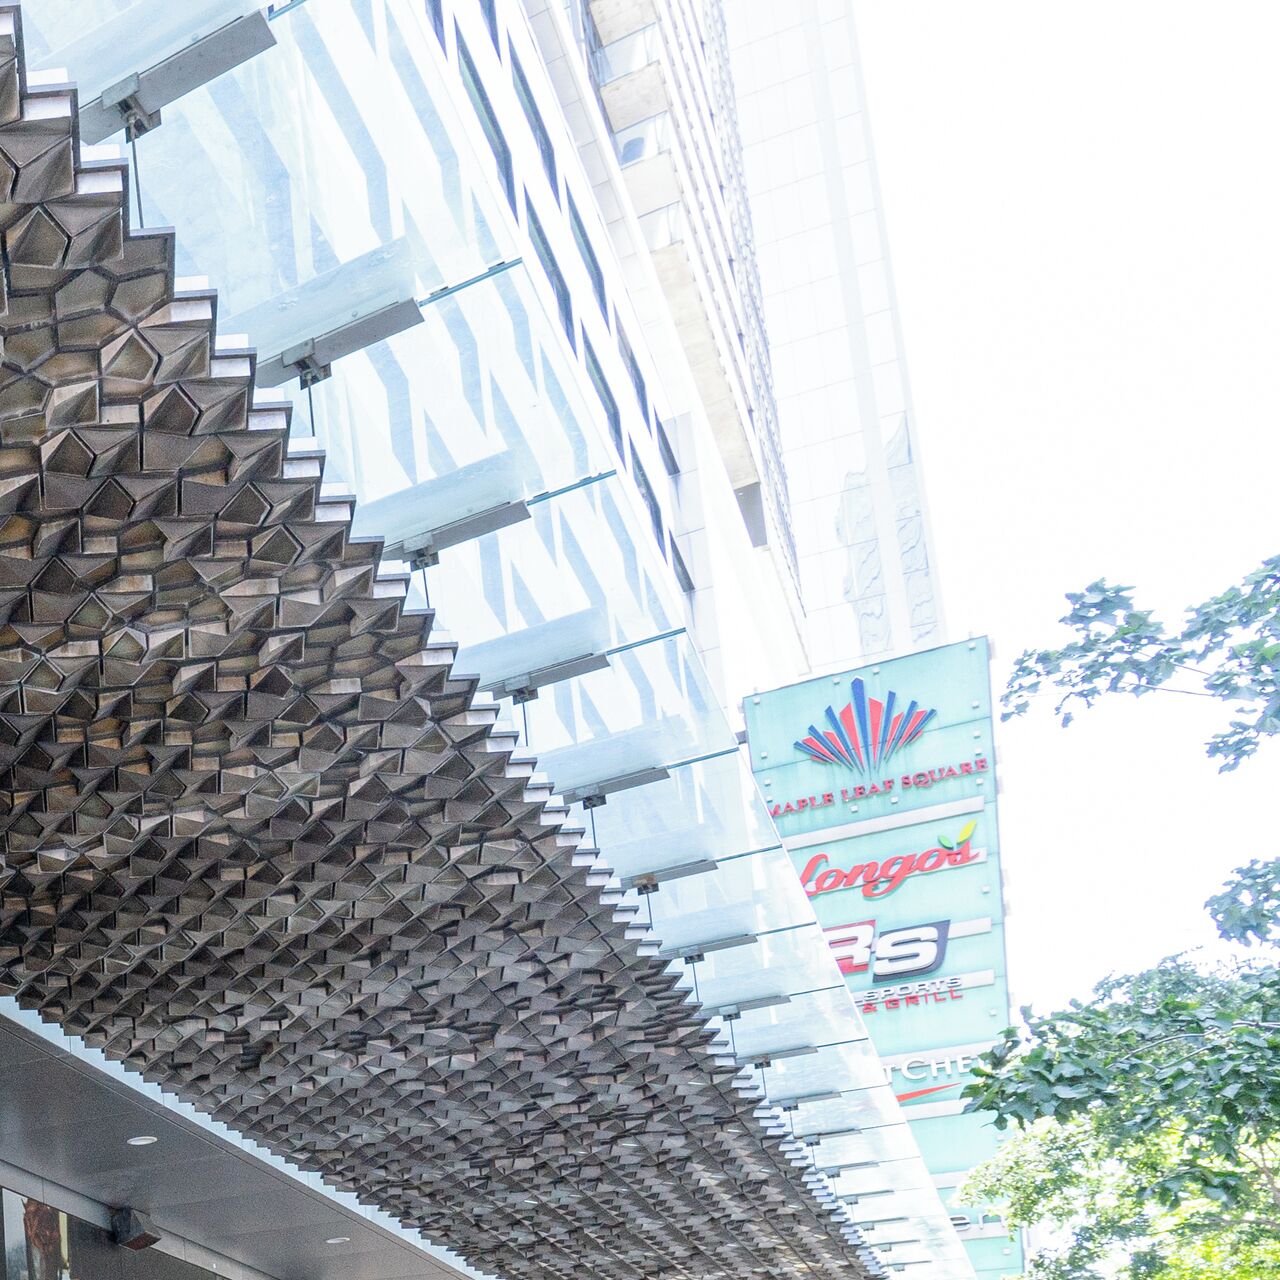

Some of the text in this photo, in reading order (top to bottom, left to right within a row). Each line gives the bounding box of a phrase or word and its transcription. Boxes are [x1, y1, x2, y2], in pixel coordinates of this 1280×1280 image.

[770, 757, 989, 818] MAPLE LEAF SQUARE
[863, 977, 962, 1002] SPORTS
[884, 988, 963, 1010] GRILL
